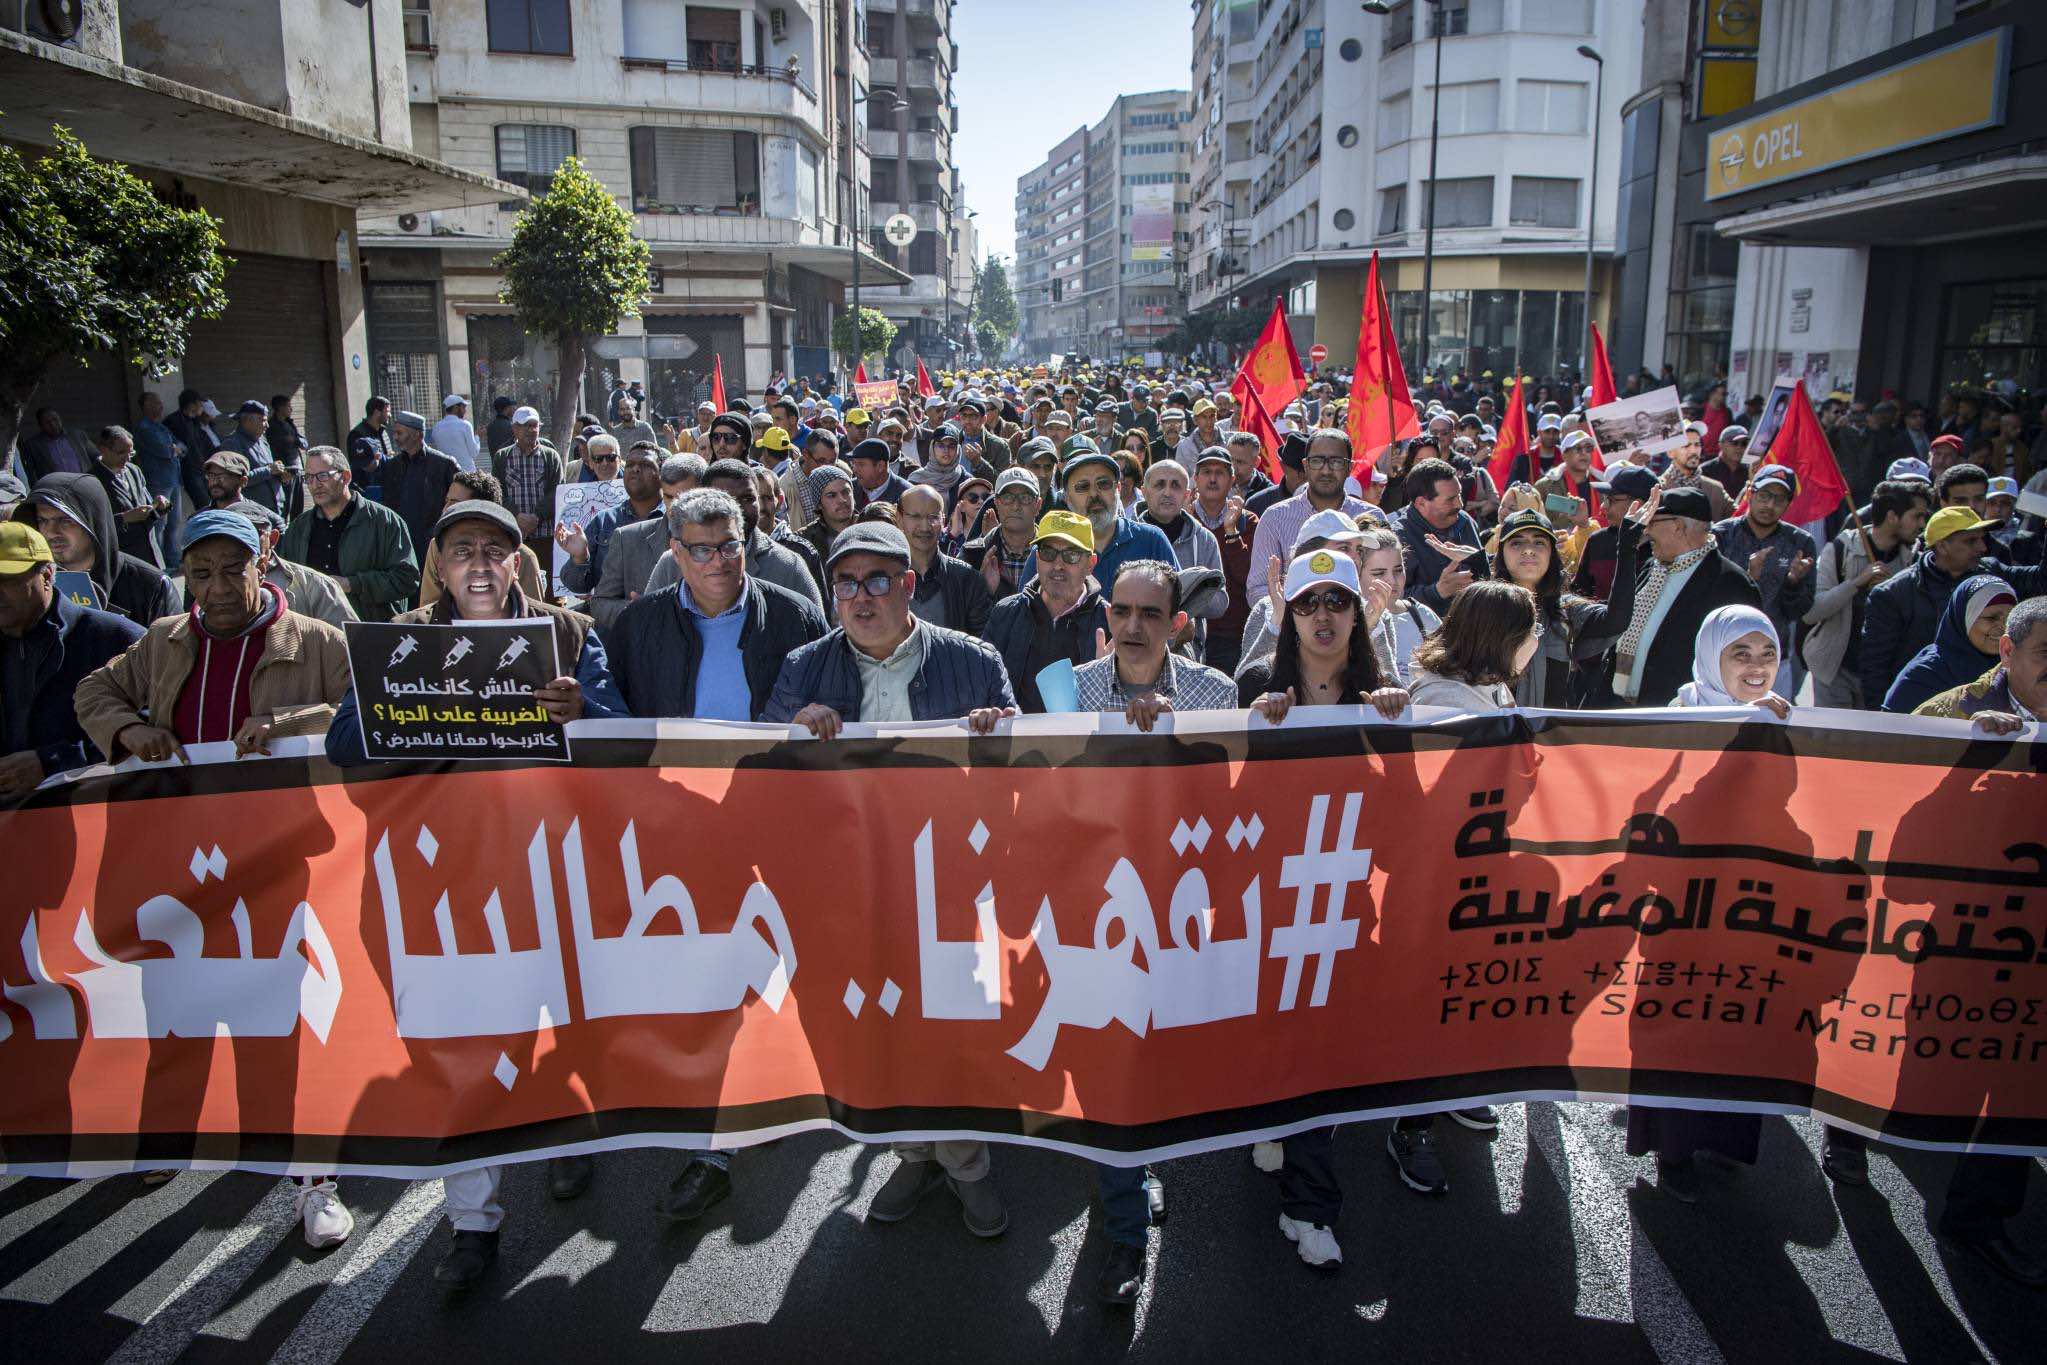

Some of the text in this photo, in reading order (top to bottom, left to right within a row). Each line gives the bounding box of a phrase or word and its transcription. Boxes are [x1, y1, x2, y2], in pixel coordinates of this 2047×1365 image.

[1753, 121, 1803, 169] OPEL
[479, 677, 534, 699] علاش
[433, 705, 477, 723] على
[482, 704, 549, 726] الضريبة
[1448, 873, 1717, 946] المغربية
[373, 815, 798, 1092] مطالبنا
[1440, 990, 1576, 1025] Front
[1600, 993, 1769, 1025] Social
